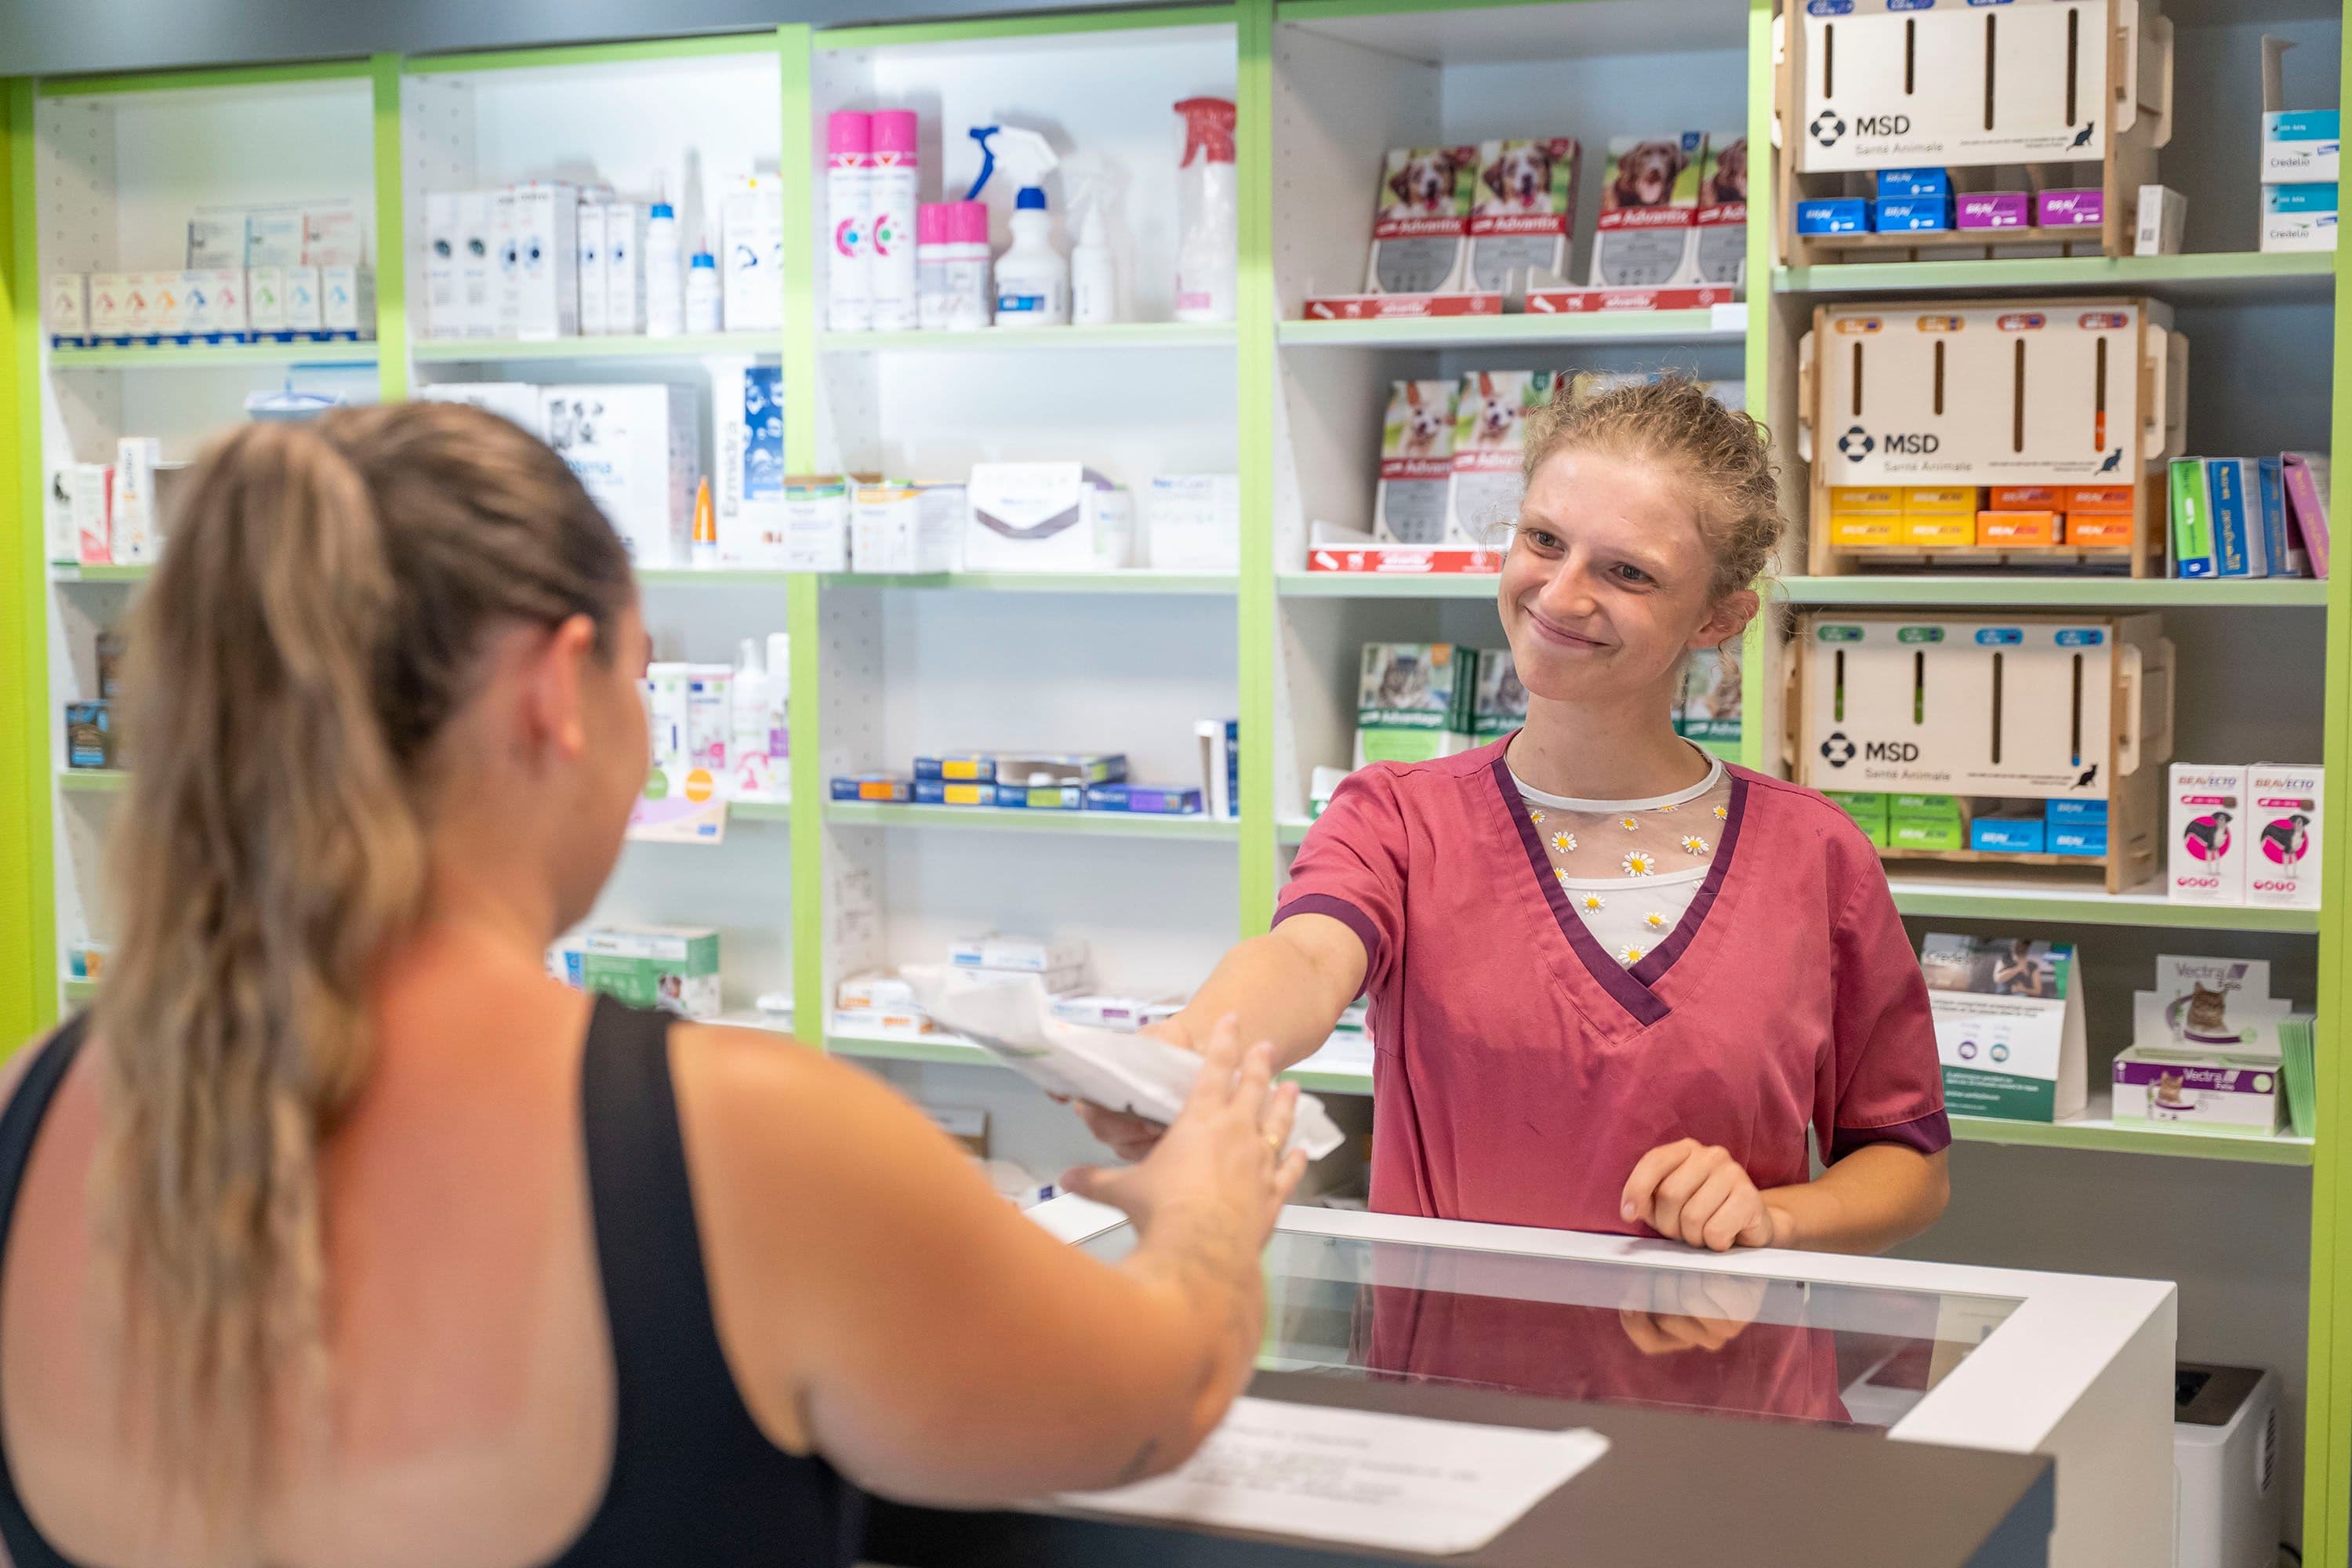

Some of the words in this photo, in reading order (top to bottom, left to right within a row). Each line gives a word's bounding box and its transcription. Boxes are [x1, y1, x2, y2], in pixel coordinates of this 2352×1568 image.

[1857, 115, 1911, 136] MSD
[1884, 434, 1940, 455] MSD
[1865, 742, 1919, 762] MSD
[2176, 962, 2225, 979] Vectra
[2183, 1067, 2223, 1083] Vectra
